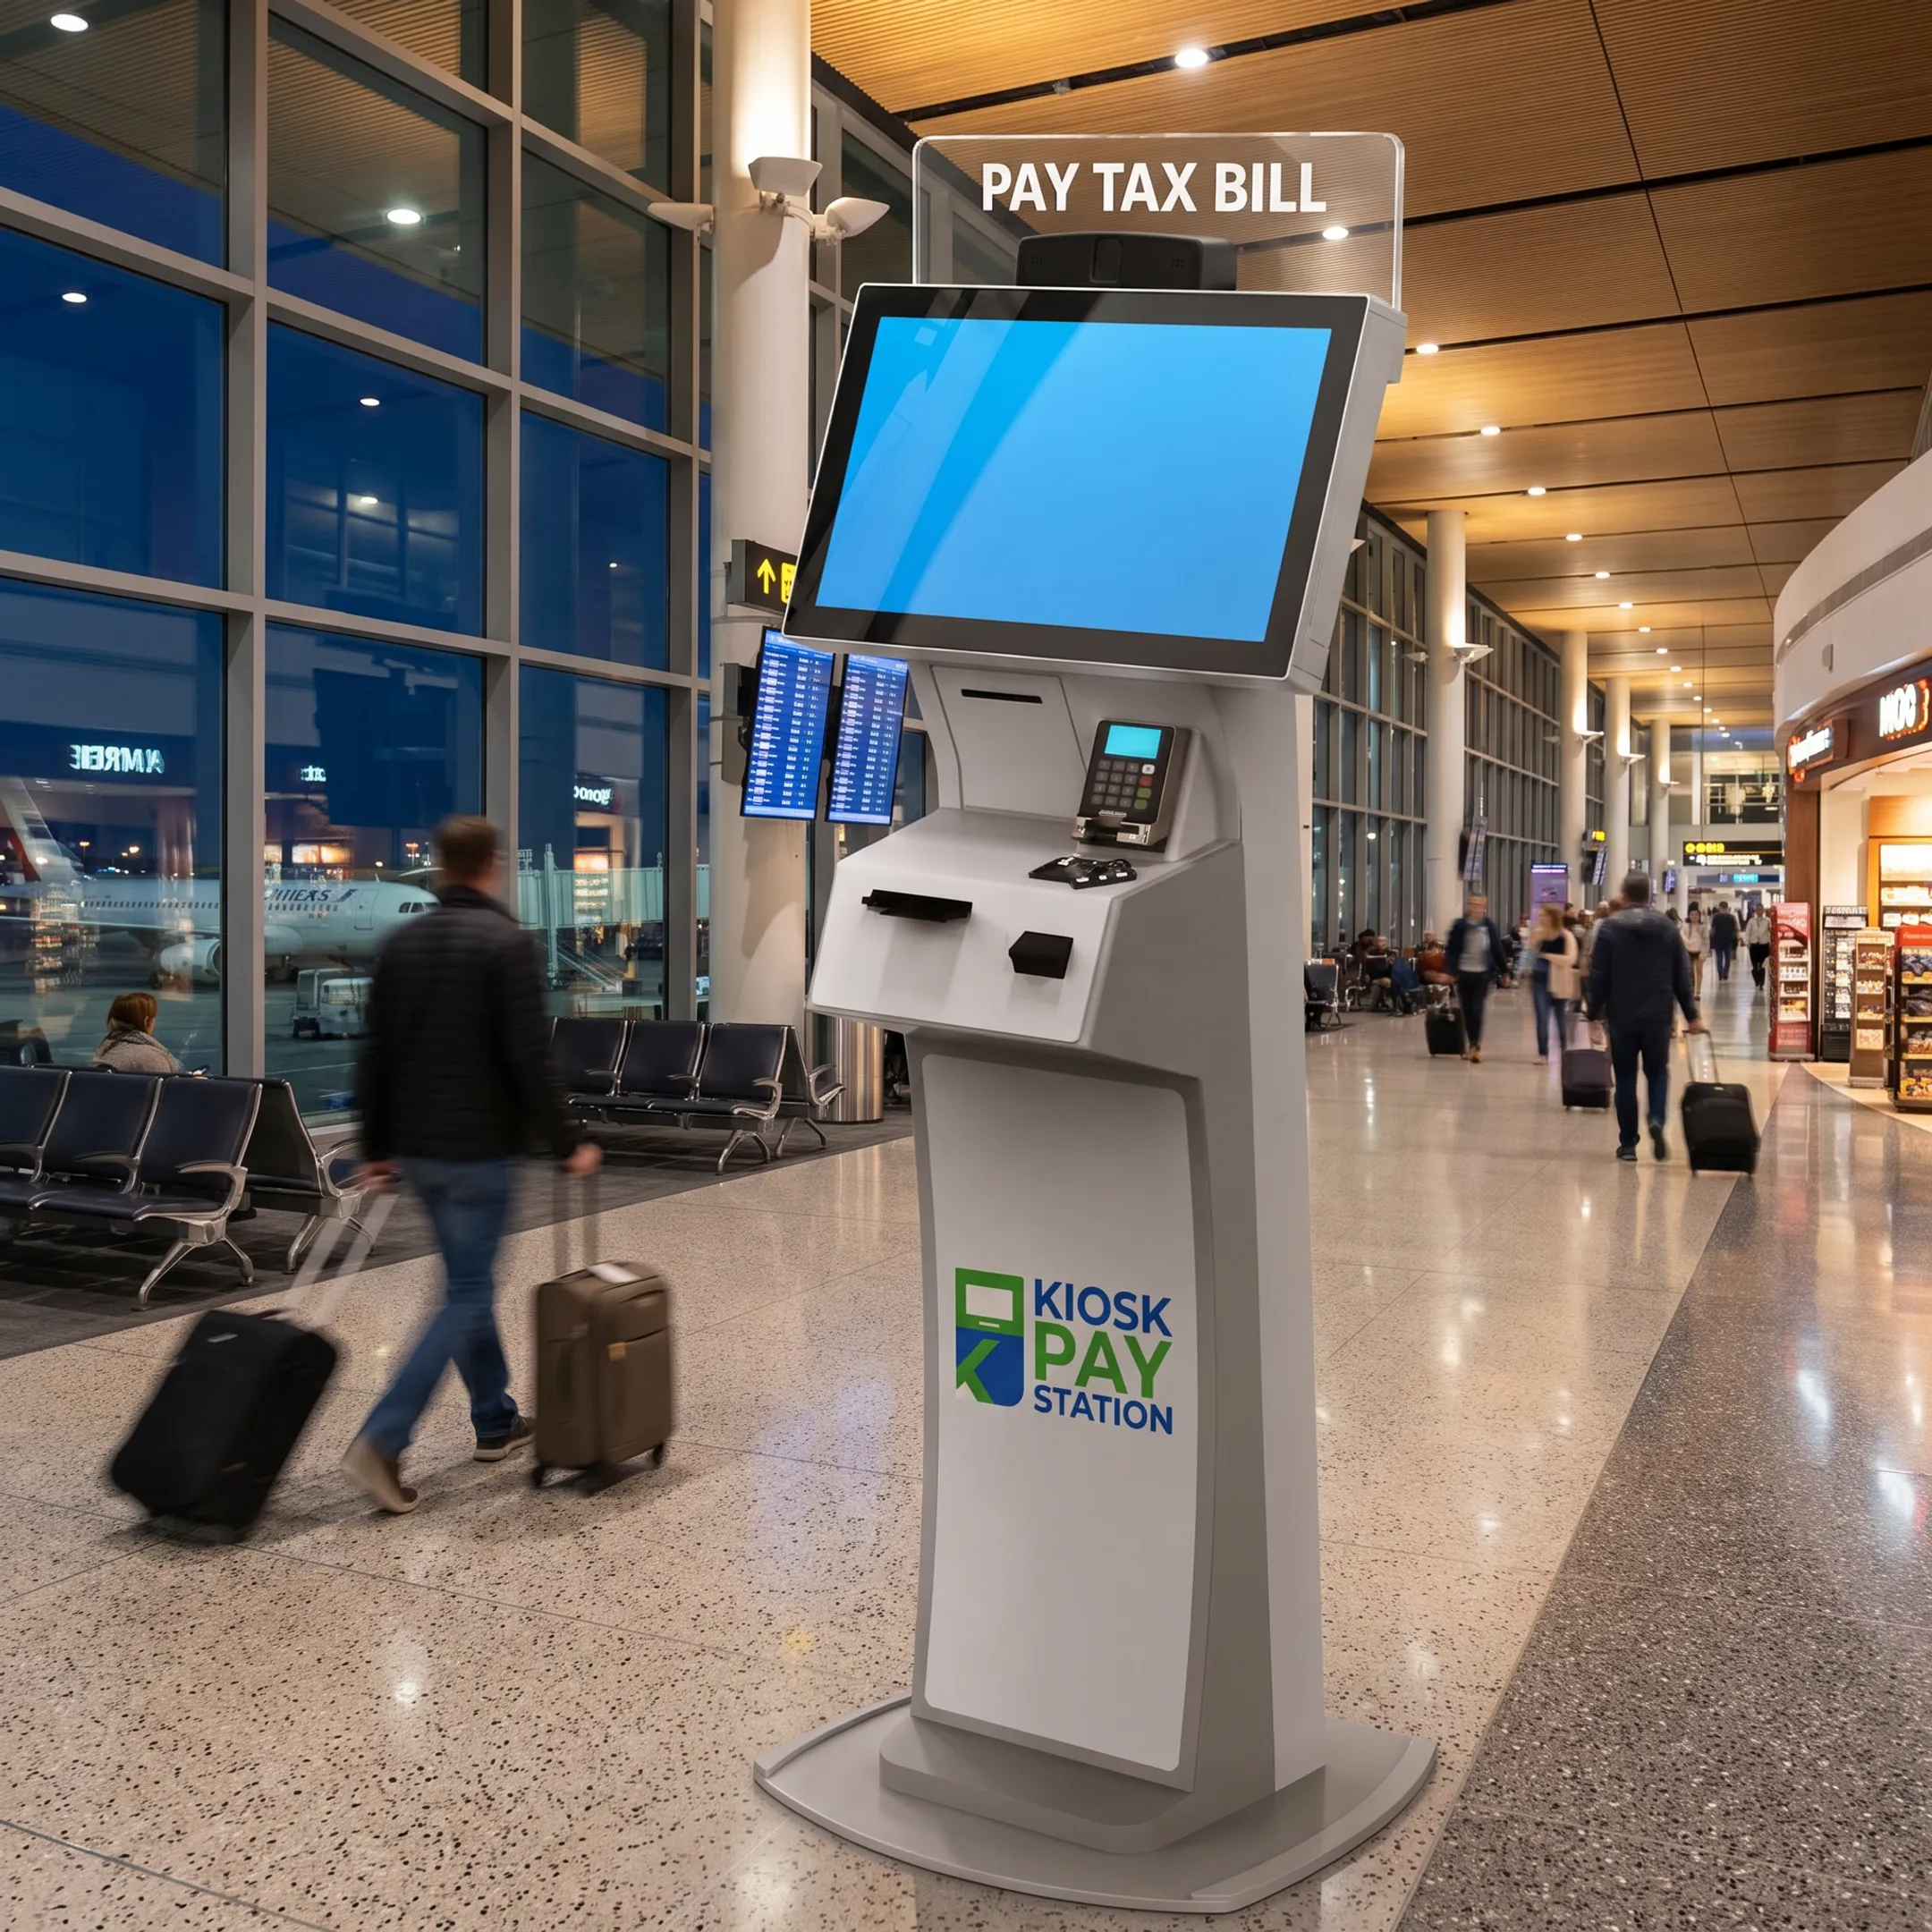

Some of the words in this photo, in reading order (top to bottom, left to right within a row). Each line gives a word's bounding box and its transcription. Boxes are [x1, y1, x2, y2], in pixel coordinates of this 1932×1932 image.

[982, 163, 1080, 212] PAY
[1092, 163, 1198, 212] TAX
[1214, 162, 1326, 213] BILL
[1034, 1278, 1173, 1337] KIOSK
[1034, 1320, 1173, 1400] PAY
[1034, 1385, 1173, 1435] STATION
